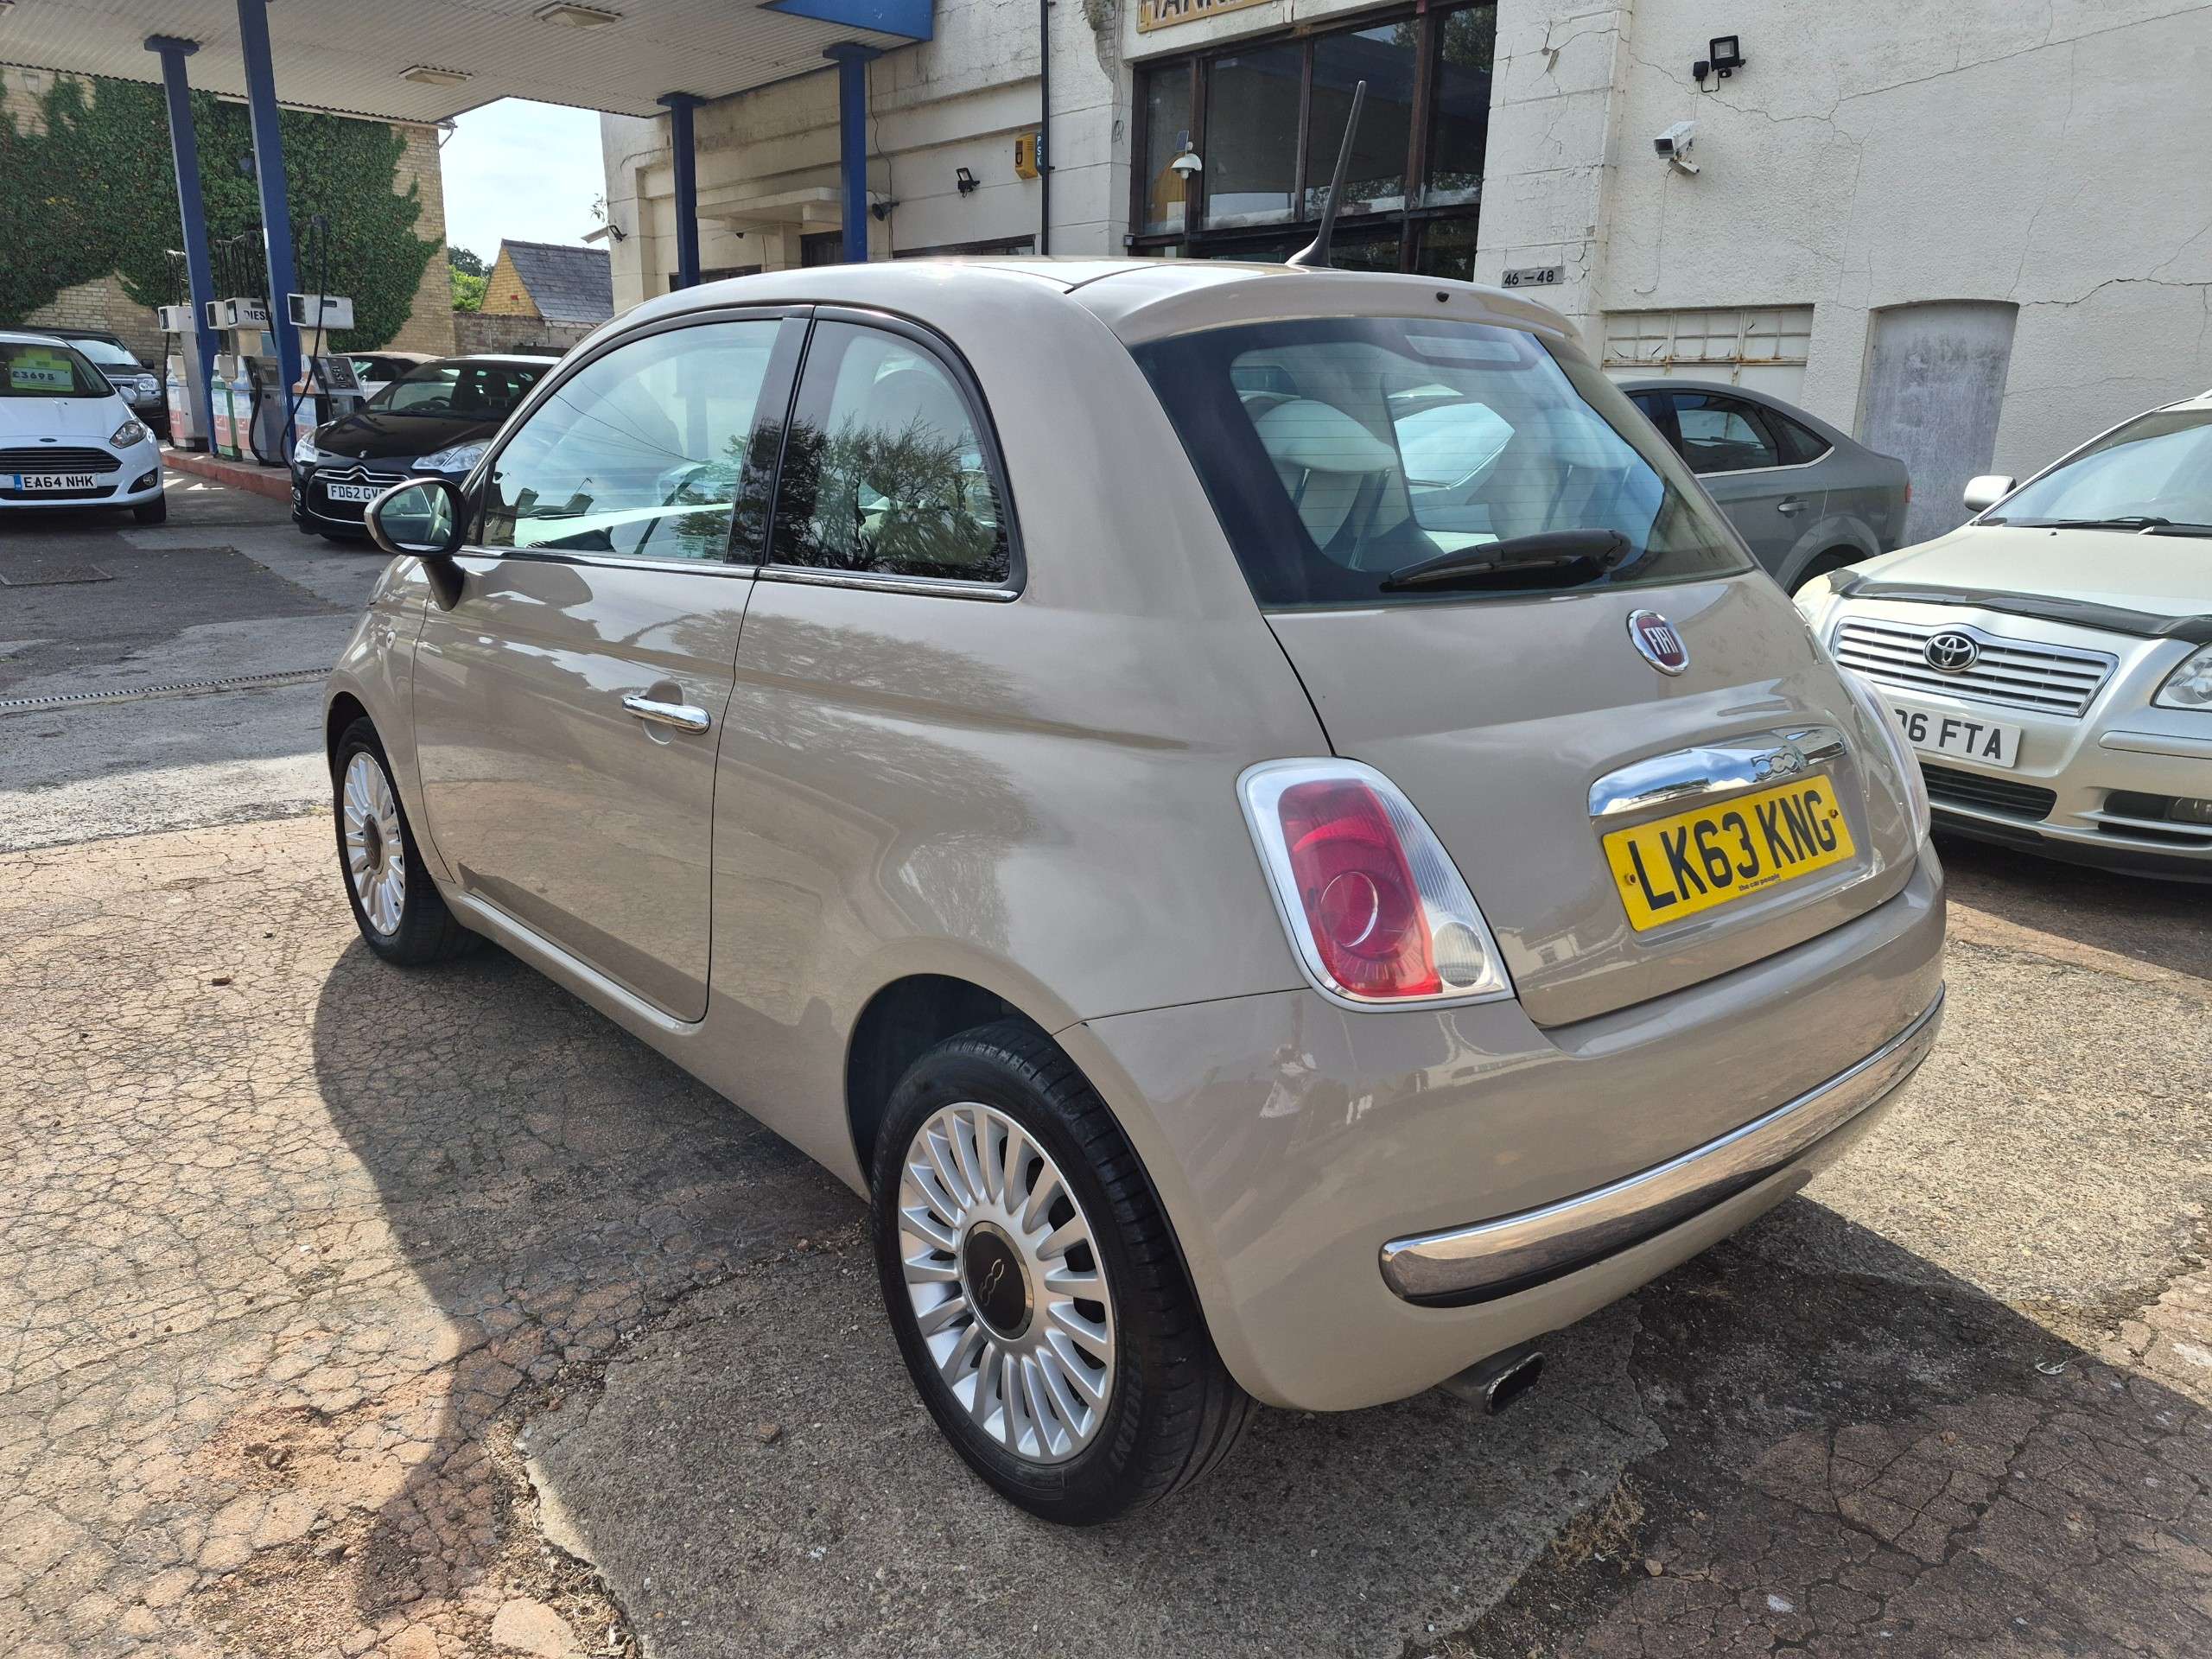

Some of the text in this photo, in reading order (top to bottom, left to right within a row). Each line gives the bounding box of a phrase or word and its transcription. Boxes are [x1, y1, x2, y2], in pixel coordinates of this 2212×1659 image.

[1504, 272, 1519, 285] 46
[1536, 270, 1554, 283] 48
[23, 476, 62, 488] EA64
[66, 475, 94, 487] NHK
[331, 486, 360, 499] FD62
[1643, 626, 1680, 655] FIAT
[1938, 718, 2002, 760] FTA
[1627, 789, 1838, 912] LK63 KNG
